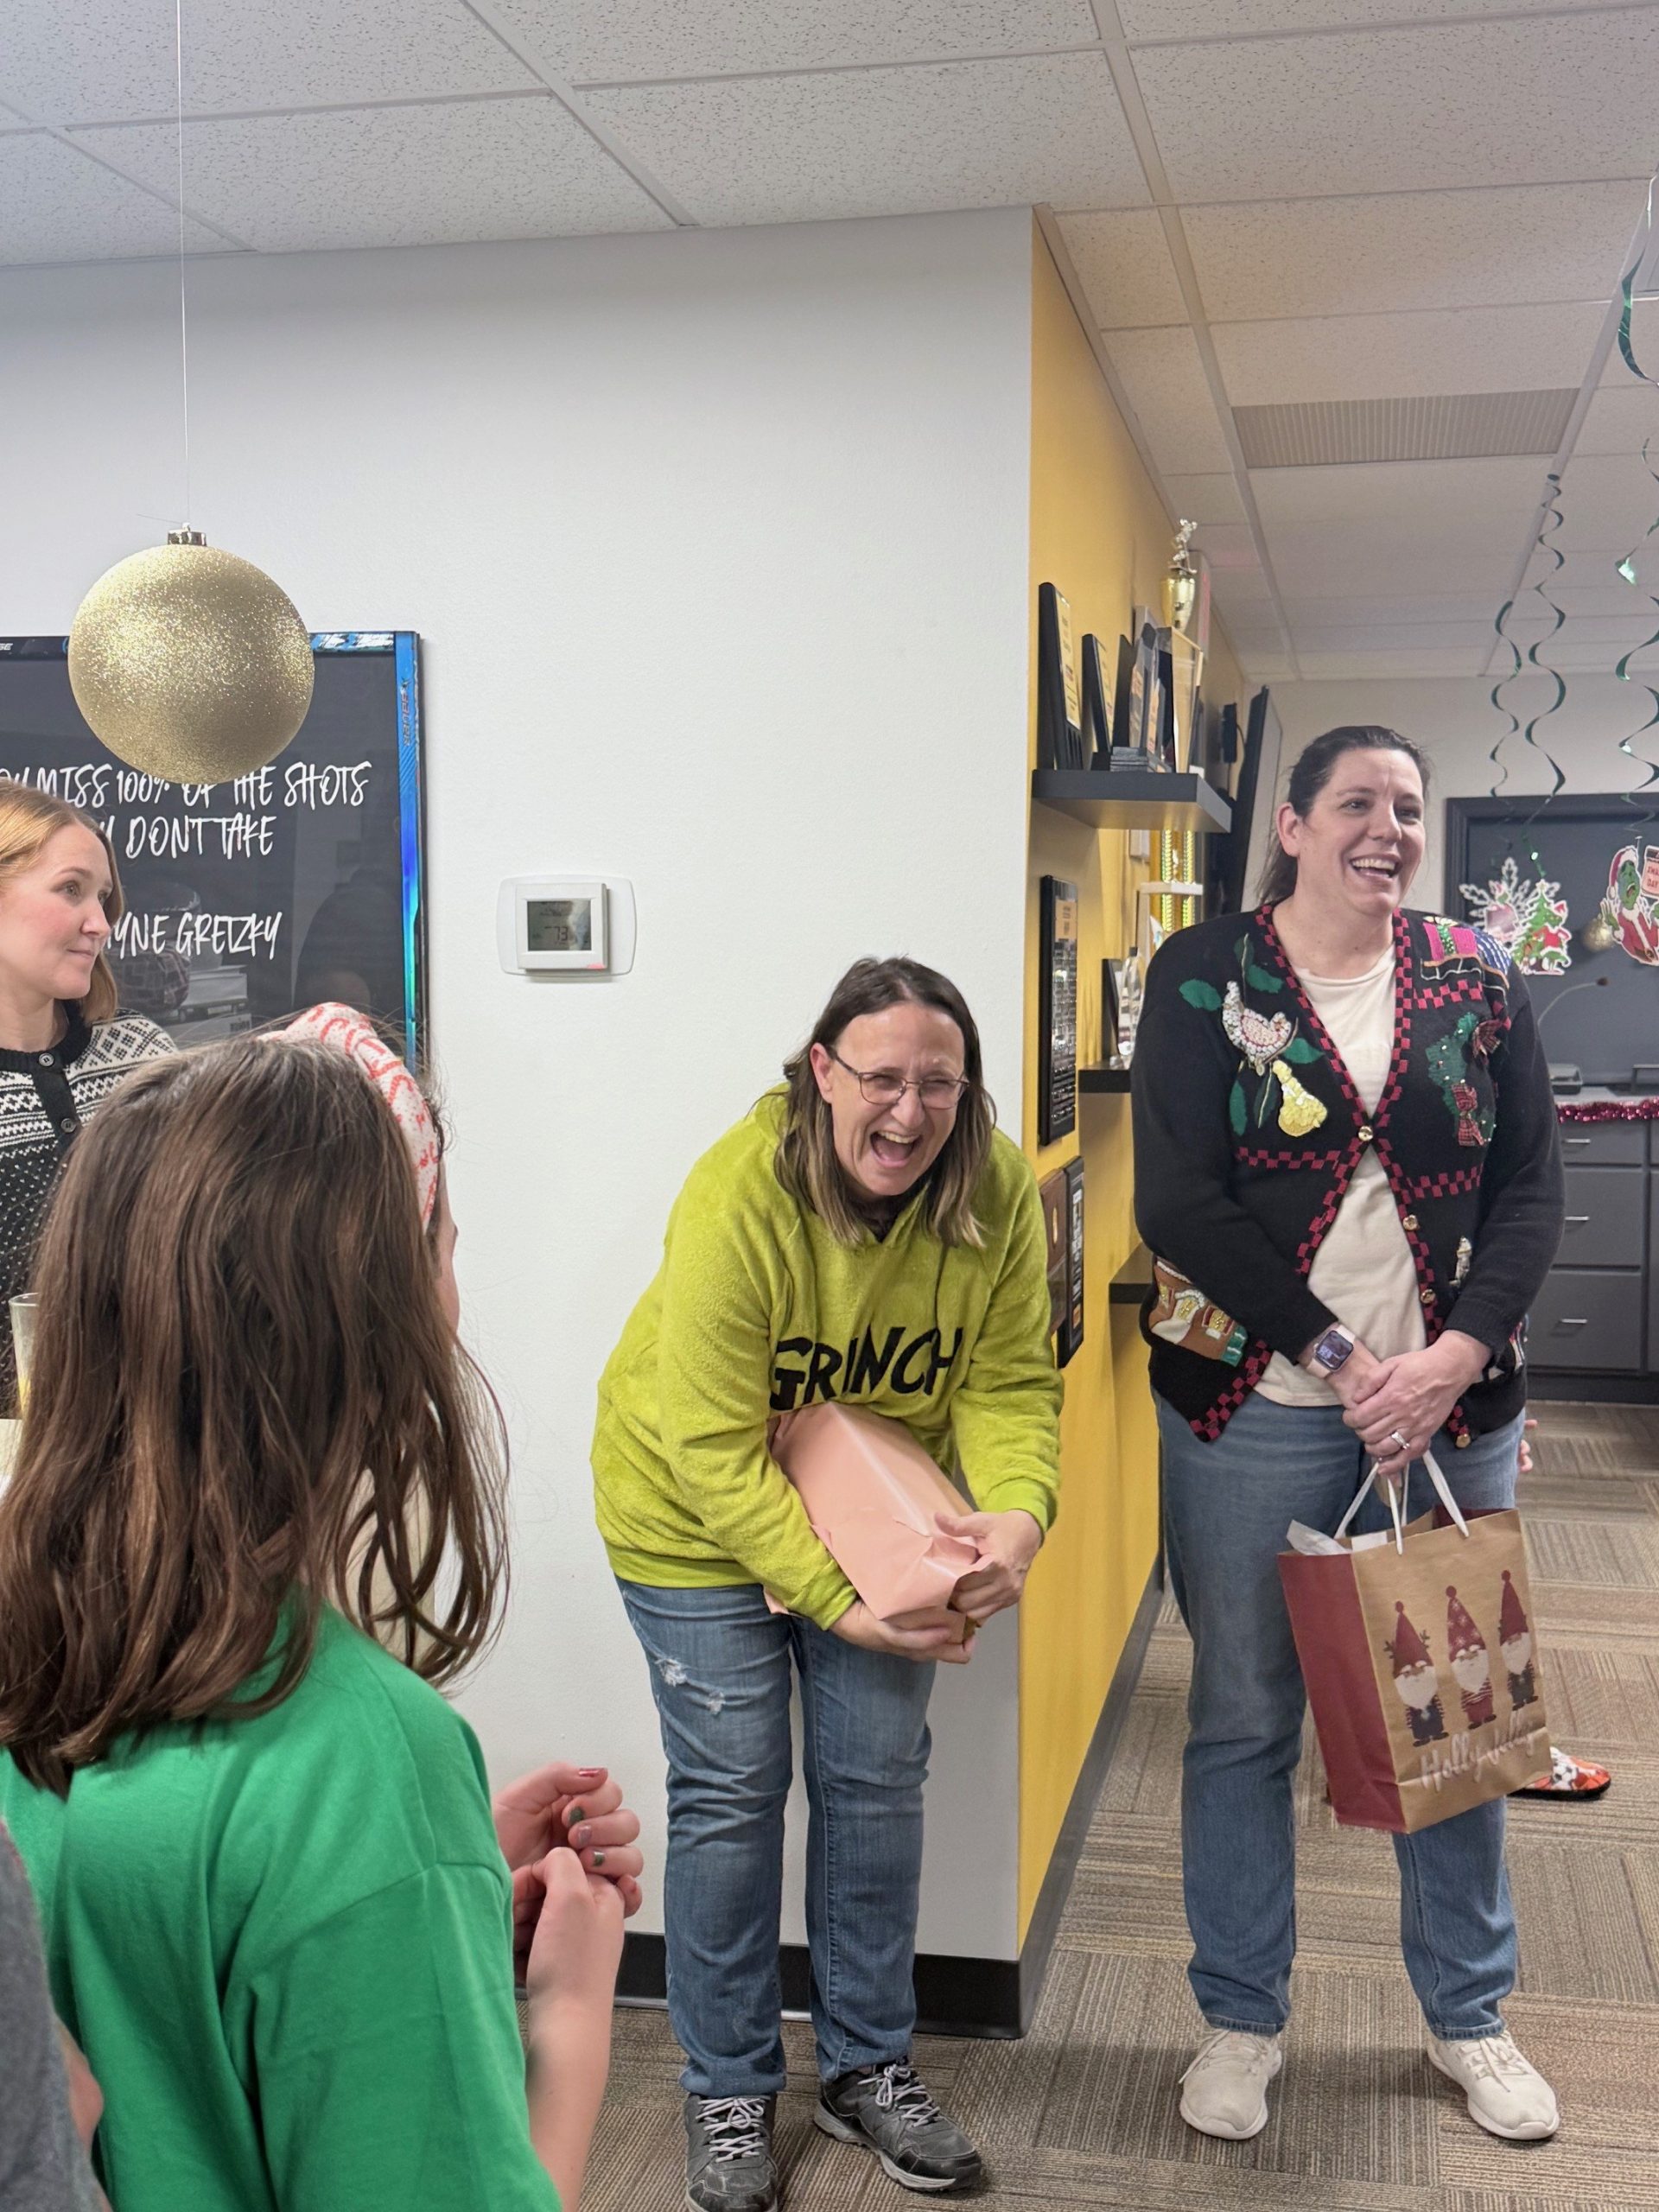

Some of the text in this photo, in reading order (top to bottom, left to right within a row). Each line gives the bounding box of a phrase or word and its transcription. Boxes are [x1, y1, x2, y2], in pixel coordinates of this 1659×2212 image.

[37, 763, 112, 808] MISS
[117, 771, 170, 804] 100%
[283, 760, 372, 810] SHOTS
[213, 812, 277, 860] TAKE
[107, 912, 283, 960] YNE GRETZKY
[769, 1324, 963, 1410] GRINCH
